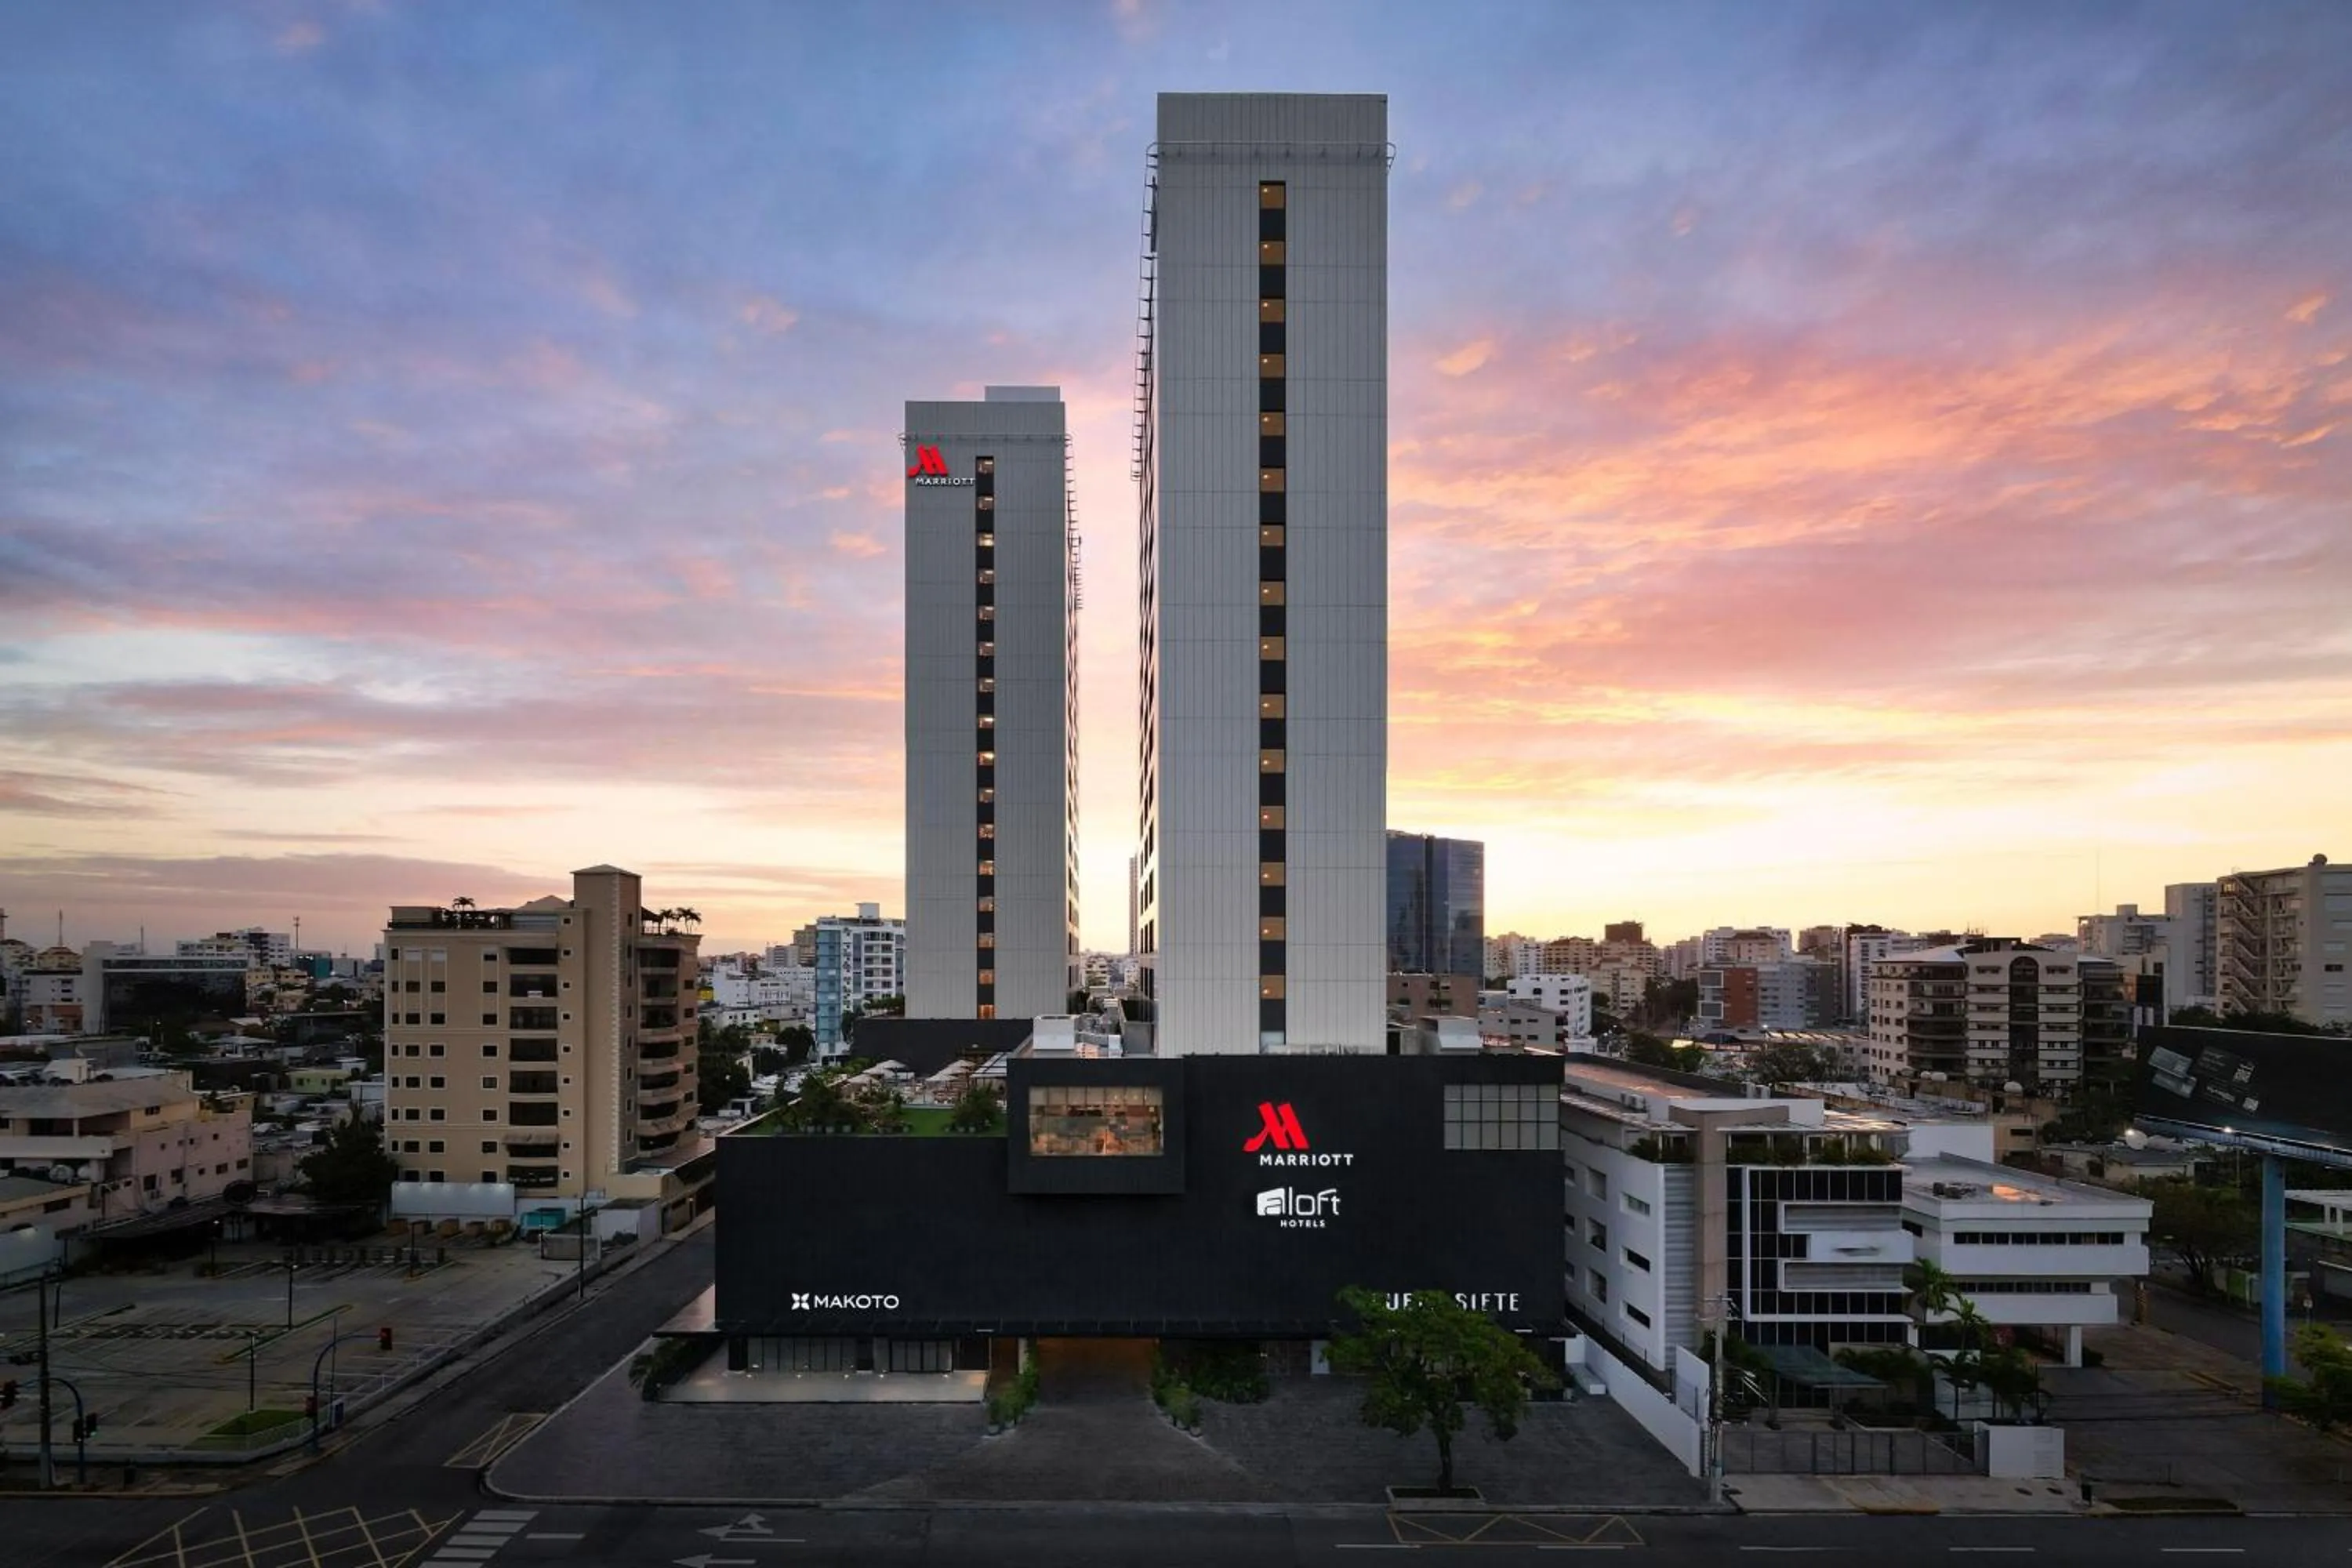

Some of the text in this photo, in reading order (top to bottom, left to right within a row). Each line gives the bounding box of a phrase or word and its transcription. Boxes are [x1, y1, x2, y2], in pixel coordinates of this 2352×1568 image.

[915, 477, 975, 486] MARRIOTT
[1260, 1153, 1354, 1167] MARRIOTT
[1256, 1186, 1341, 1217] aloft
[1280, 1218, 1326, 1229] HOTELS
[813, 1294, 900, 1309] MAKOTO
[1454, 1292, 1519, 1312] SIETE
